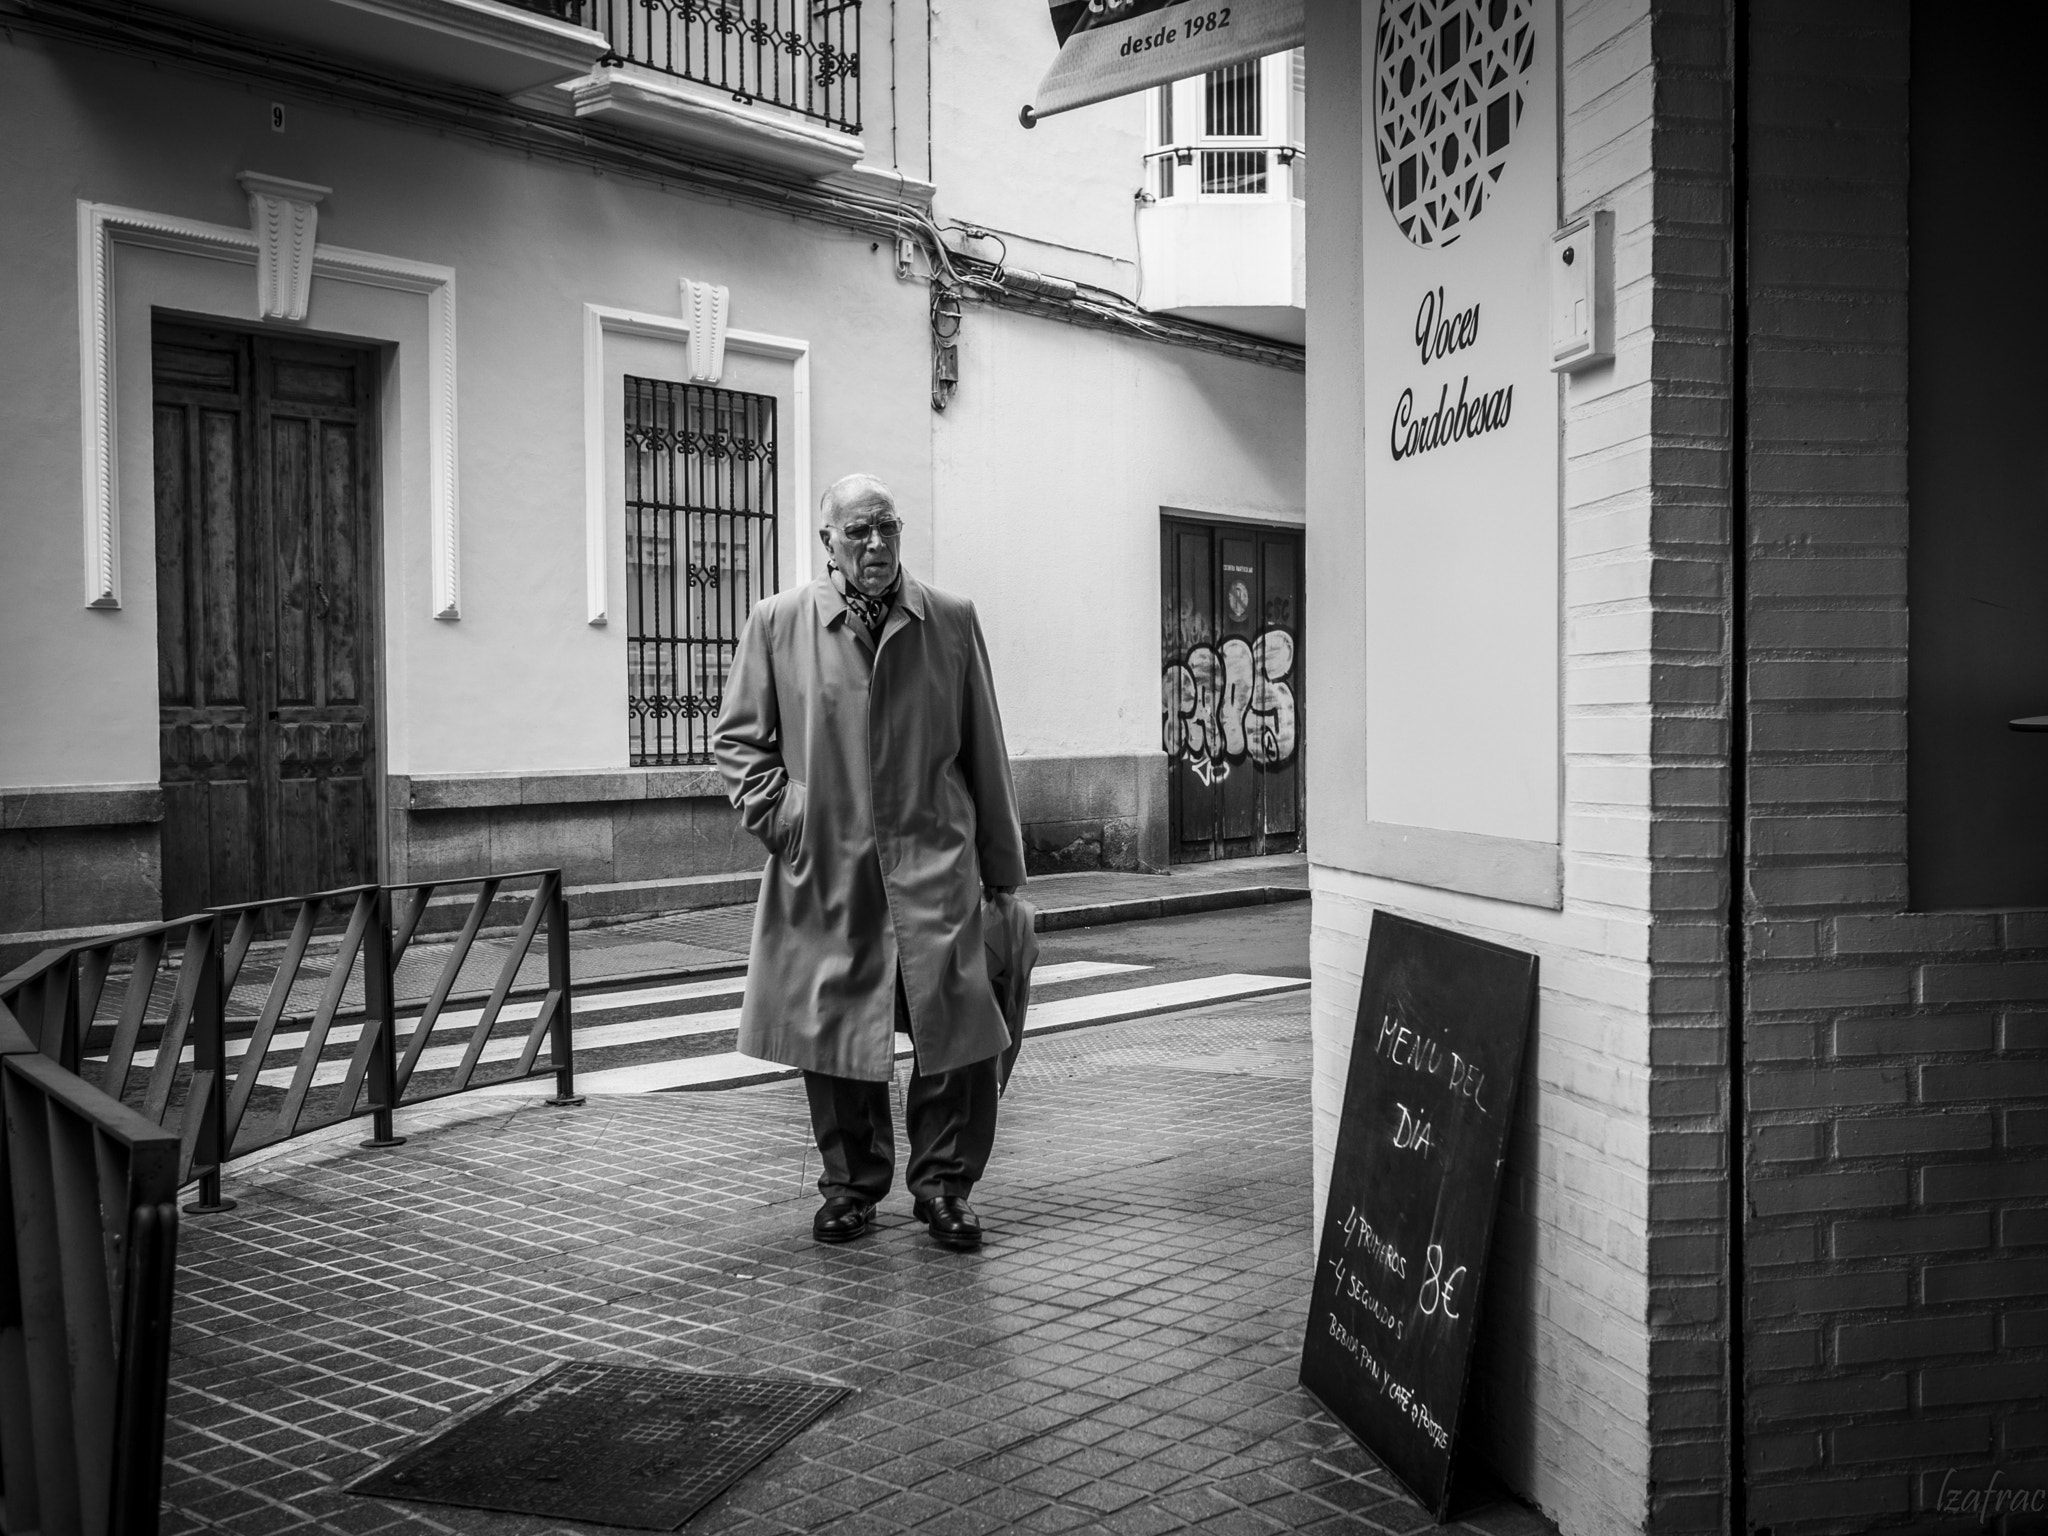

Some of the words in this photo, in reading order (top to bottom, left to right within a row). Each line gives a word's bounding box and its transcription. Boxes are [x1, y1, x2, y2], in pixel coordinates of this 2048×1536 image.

[1120, 26, 1176, 57] desde
[1184, 7, 1231, 39] 1982
[273, 106, 283, 128] 9
[1415, 285, 1480, 365] Voces
[1391, 375, 1513, 461] Cordobesas
[1449, 1051, 1487, 1113] DEL
[1357, 1215, 1407, 1280] PRIMEROS
[1346, 1274, 1404, 1340] SEGUNDOS
[1419, 1244, 1467, 1319] 8€
[1360, 1344, 1380, 1379] PAN
[1379, 1369, 1391, 1395] Y
[1416, 1403, 1449, 1449] POSTRE
